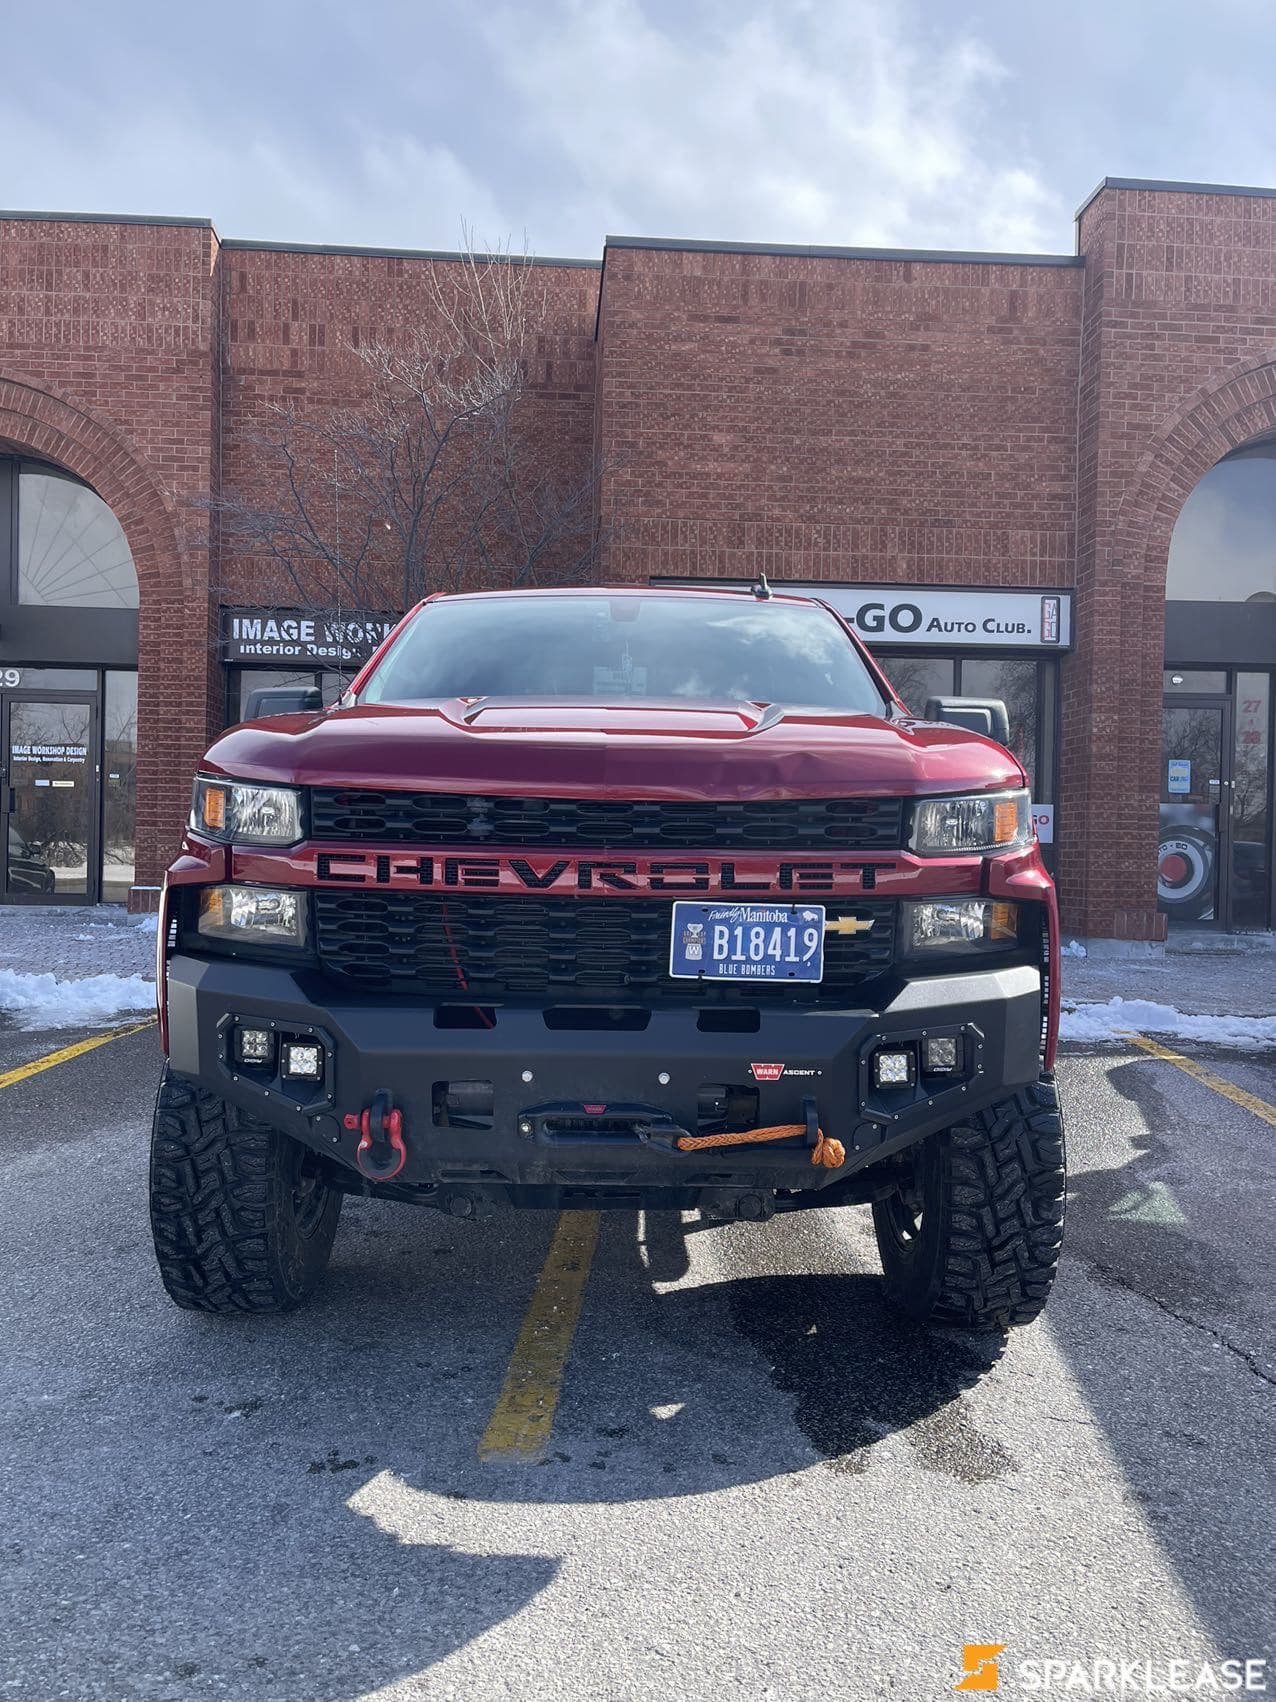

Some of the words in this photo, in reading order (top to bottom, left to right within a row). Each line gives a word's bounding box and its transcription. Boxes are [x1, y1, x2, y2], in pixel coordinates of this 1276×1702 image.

[232, 618, 316, 642] IMAGE
[240, 643, 302, 656] Interior
[12, 745, 31, 754] IMAGE
[32, 746, 65, 755] WORKSHOP
[66, 746, 87, 756] DESIGN
[317, 853, 897, 891] CHEVROLET
[740, 907, 789, 923] Manitoba
[713, 925, 819, 962] B18419
[718, 963, 738, 975] BLUE
[741, 964, 776, 977] BOMBERS
